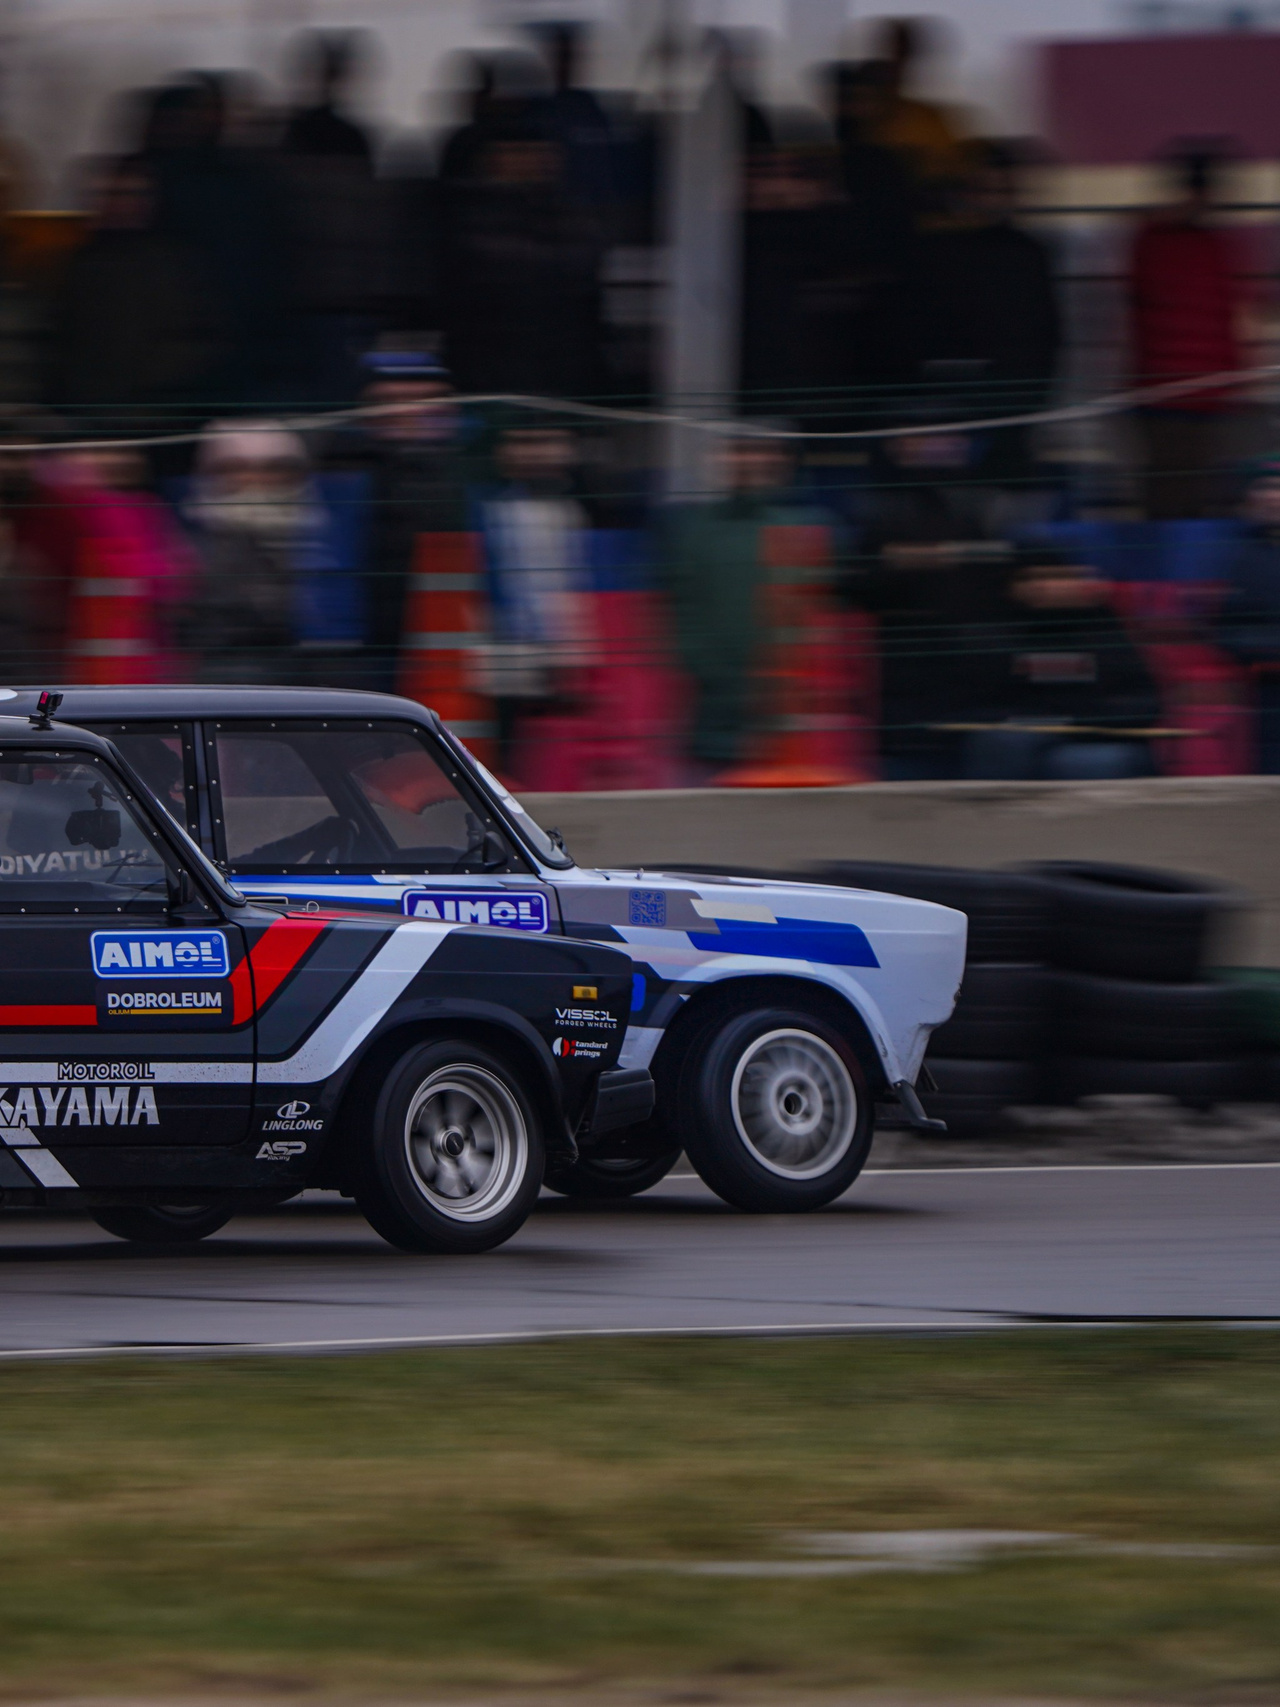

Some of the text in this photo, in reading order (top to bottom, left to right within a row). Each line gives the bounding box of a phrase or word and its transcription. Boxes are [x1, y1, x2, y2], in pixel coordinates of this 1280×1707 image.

[413, 900, 540, 925] AIMOL
[100, 941, 222, 967] AIMOL
[108, 992, 222, 1008] DOBROLEUM
[555, 1008, 618, 1022] VISSOL
[262, 1120, 324, 1130] LINGLONG
[255, 1141, 307, 1158] ASP
